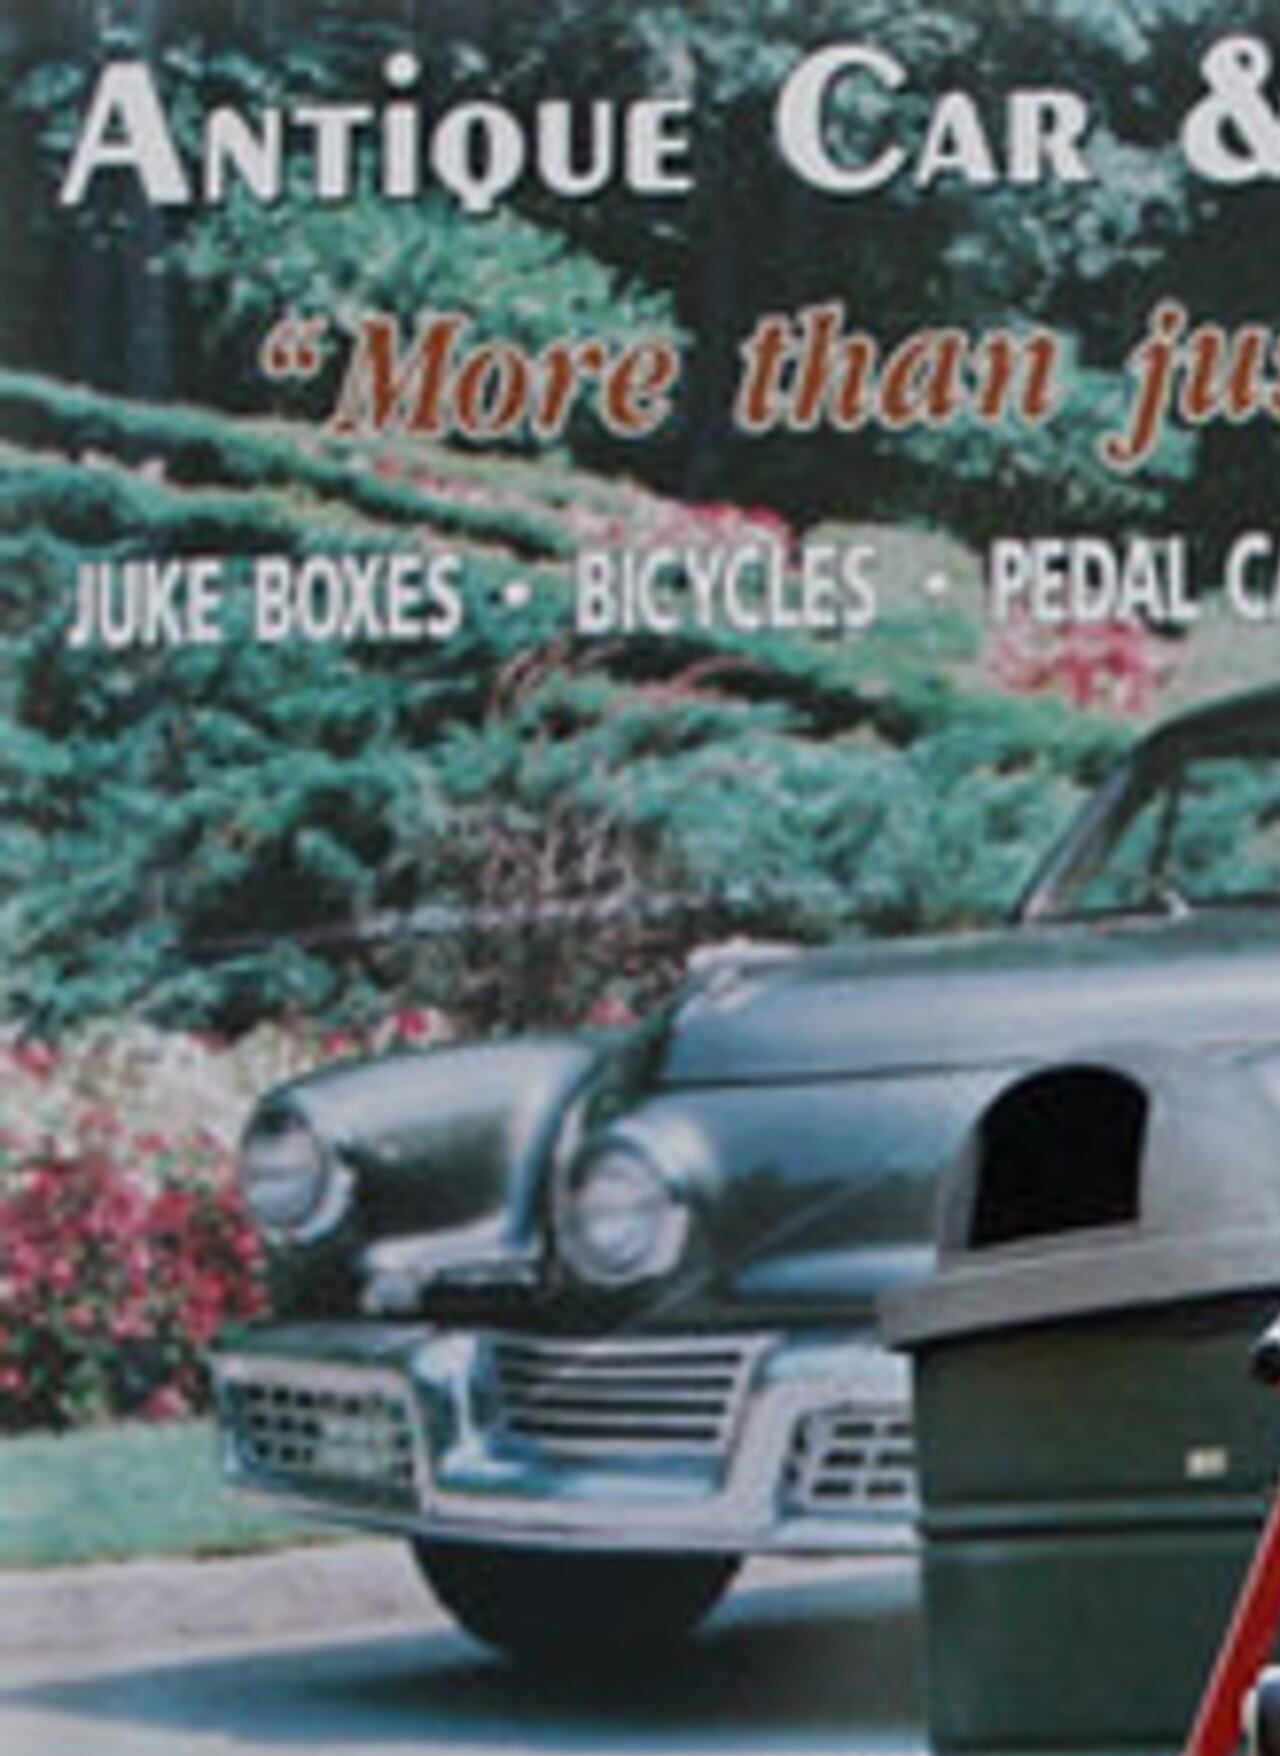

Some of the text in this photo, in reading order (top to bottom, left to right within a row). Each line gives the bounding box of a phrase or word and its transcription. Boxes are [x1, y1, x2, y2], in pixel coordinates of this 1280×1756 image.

[776, 45, 1092, 193] CAR
[732, 302, 1062, 430] than
[67, 562, 221, 646] JUKE
[252, 548, 464, 644] BOXES
[574, 538, 880, 634] BICYCLES
[988, 535, 1202, 624] PEDAL
